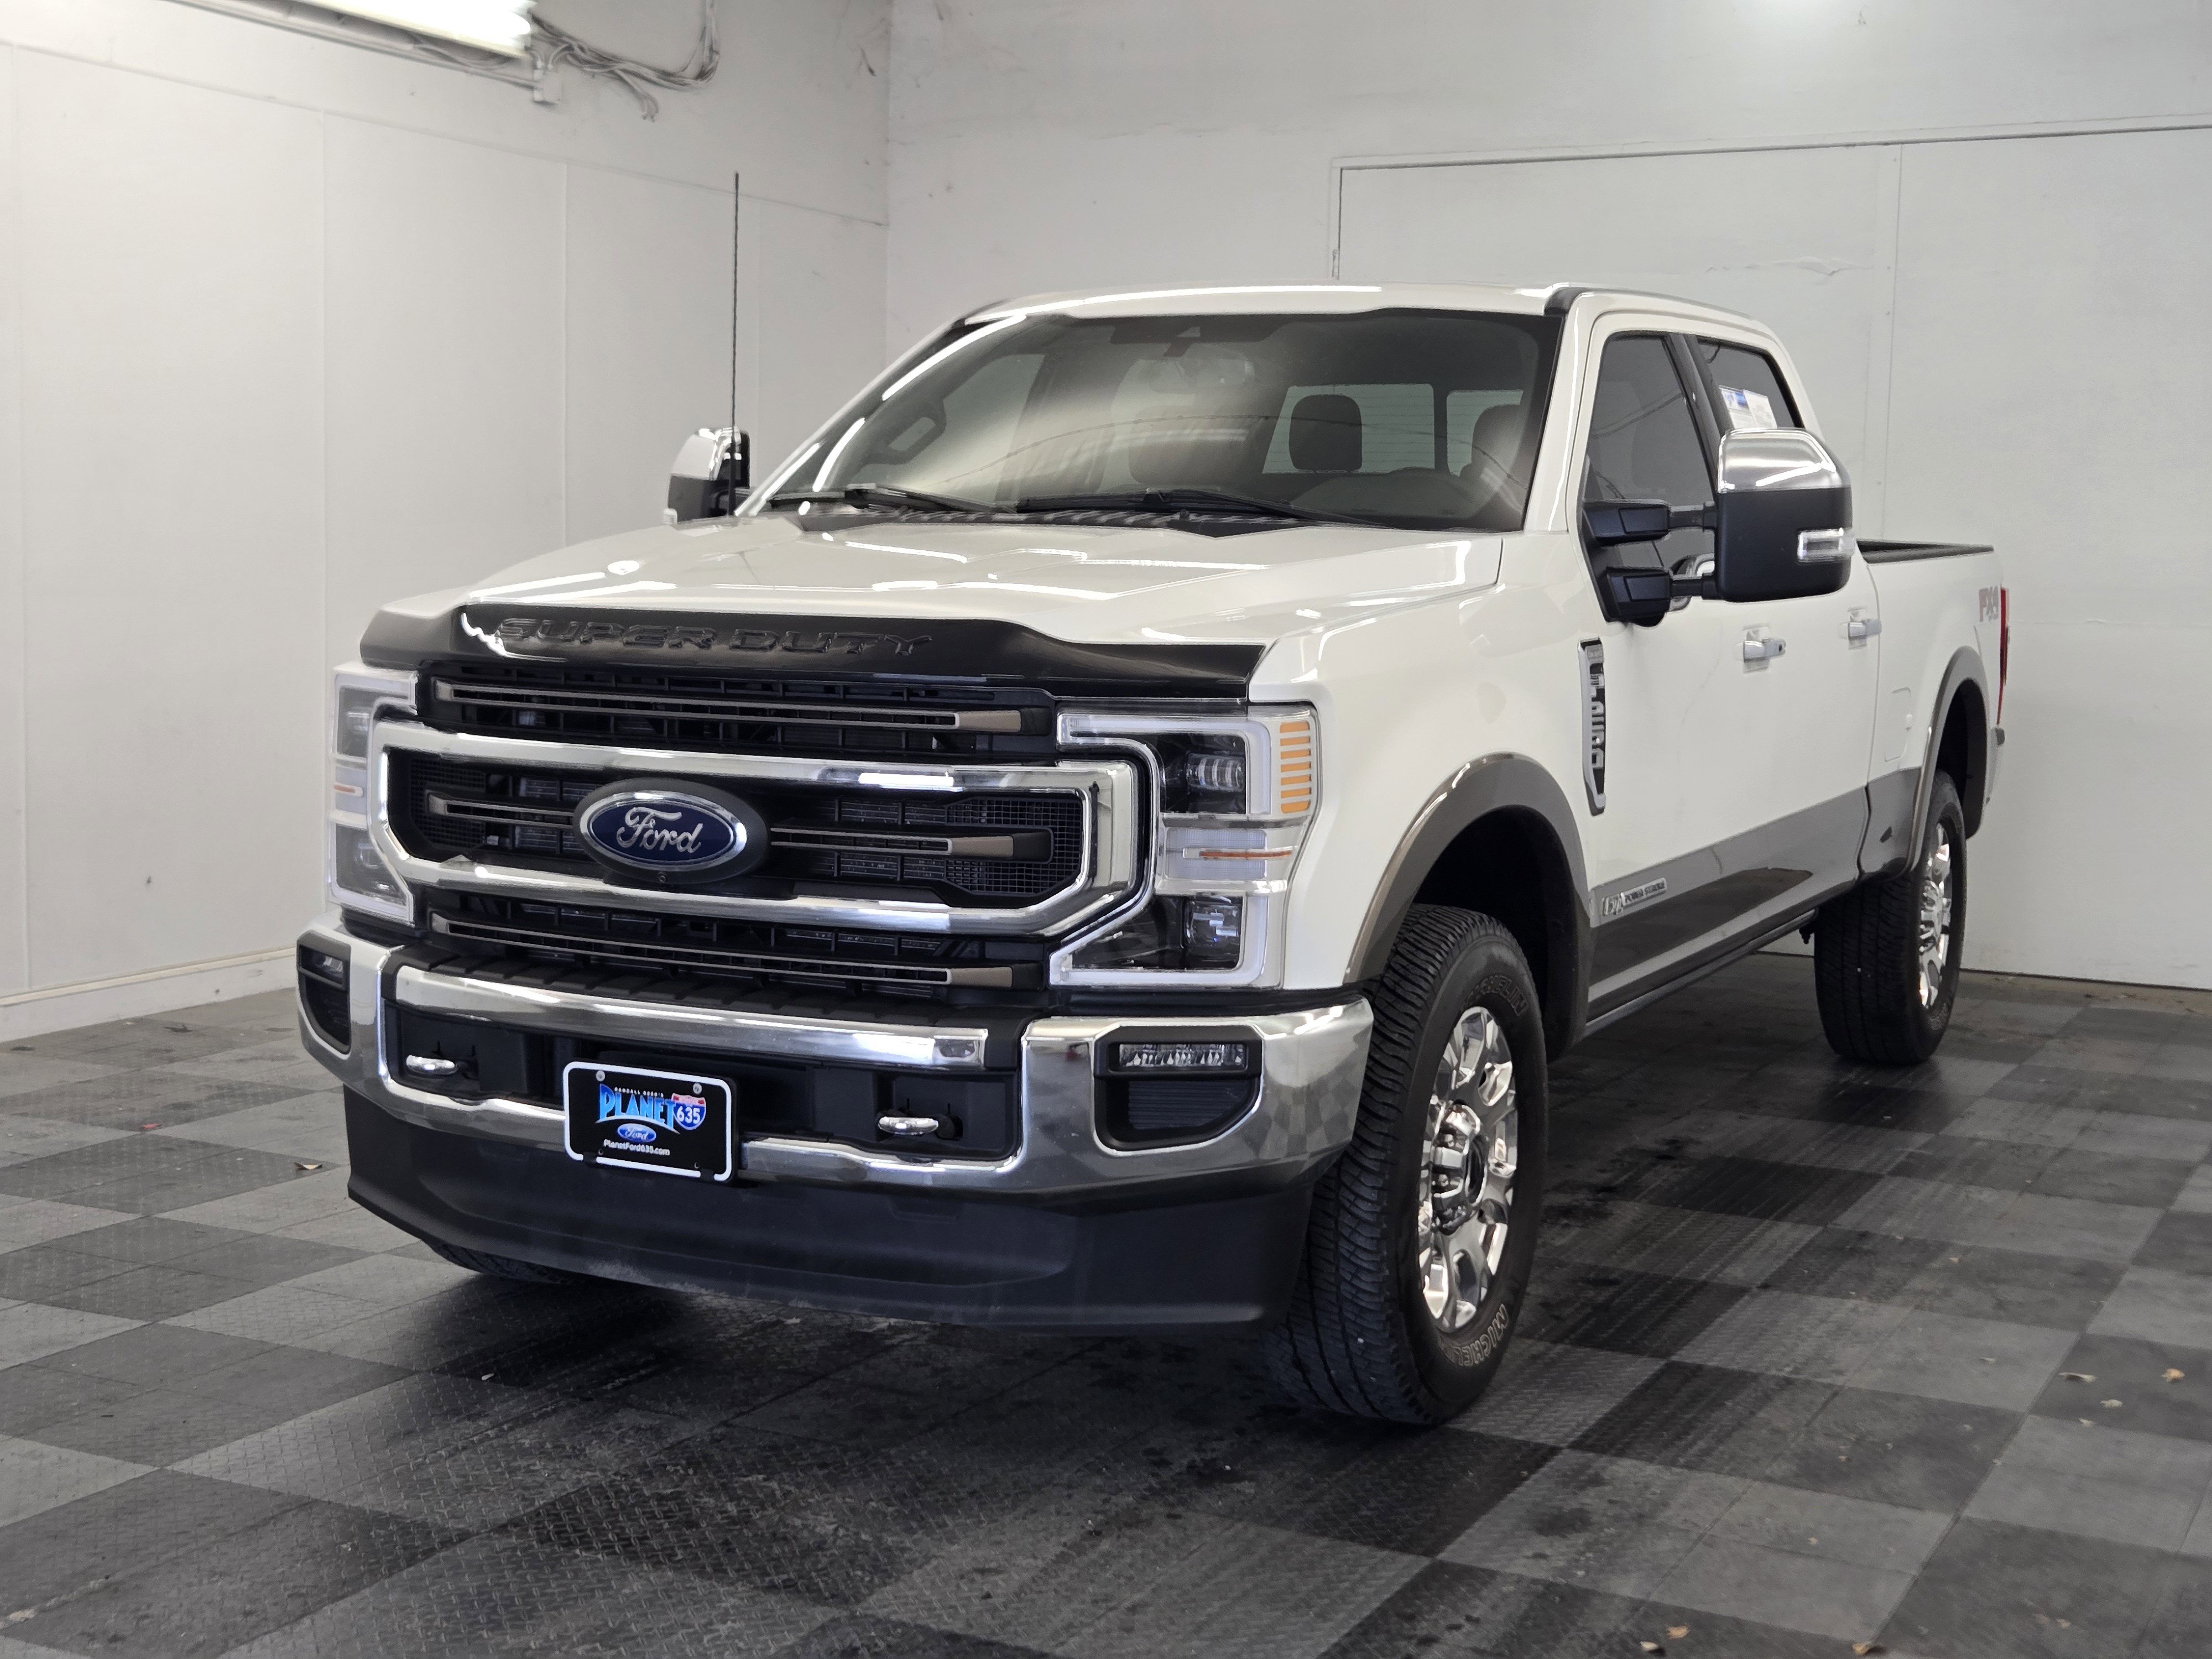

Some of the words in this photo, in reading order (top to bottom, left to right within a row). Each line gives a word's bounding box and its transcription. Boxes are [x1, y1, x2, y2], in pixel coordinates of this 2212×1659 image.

[496, 618, 718, 650] SUPER
[729, 629, 933, 656] DUTY
[617, 807, 703, 853] Ford
[1466, 974, 1527, 1016] CHELIN
[599, 1083, 676, 1129] PLANET
[676, 1107, 701, 1124] 635
[604, 1139, 670, 1156] PlanetFord635.com
[625, 1126, 650, 1140] Ford
[1439, 1303, 1509, 1366] MICHEL
